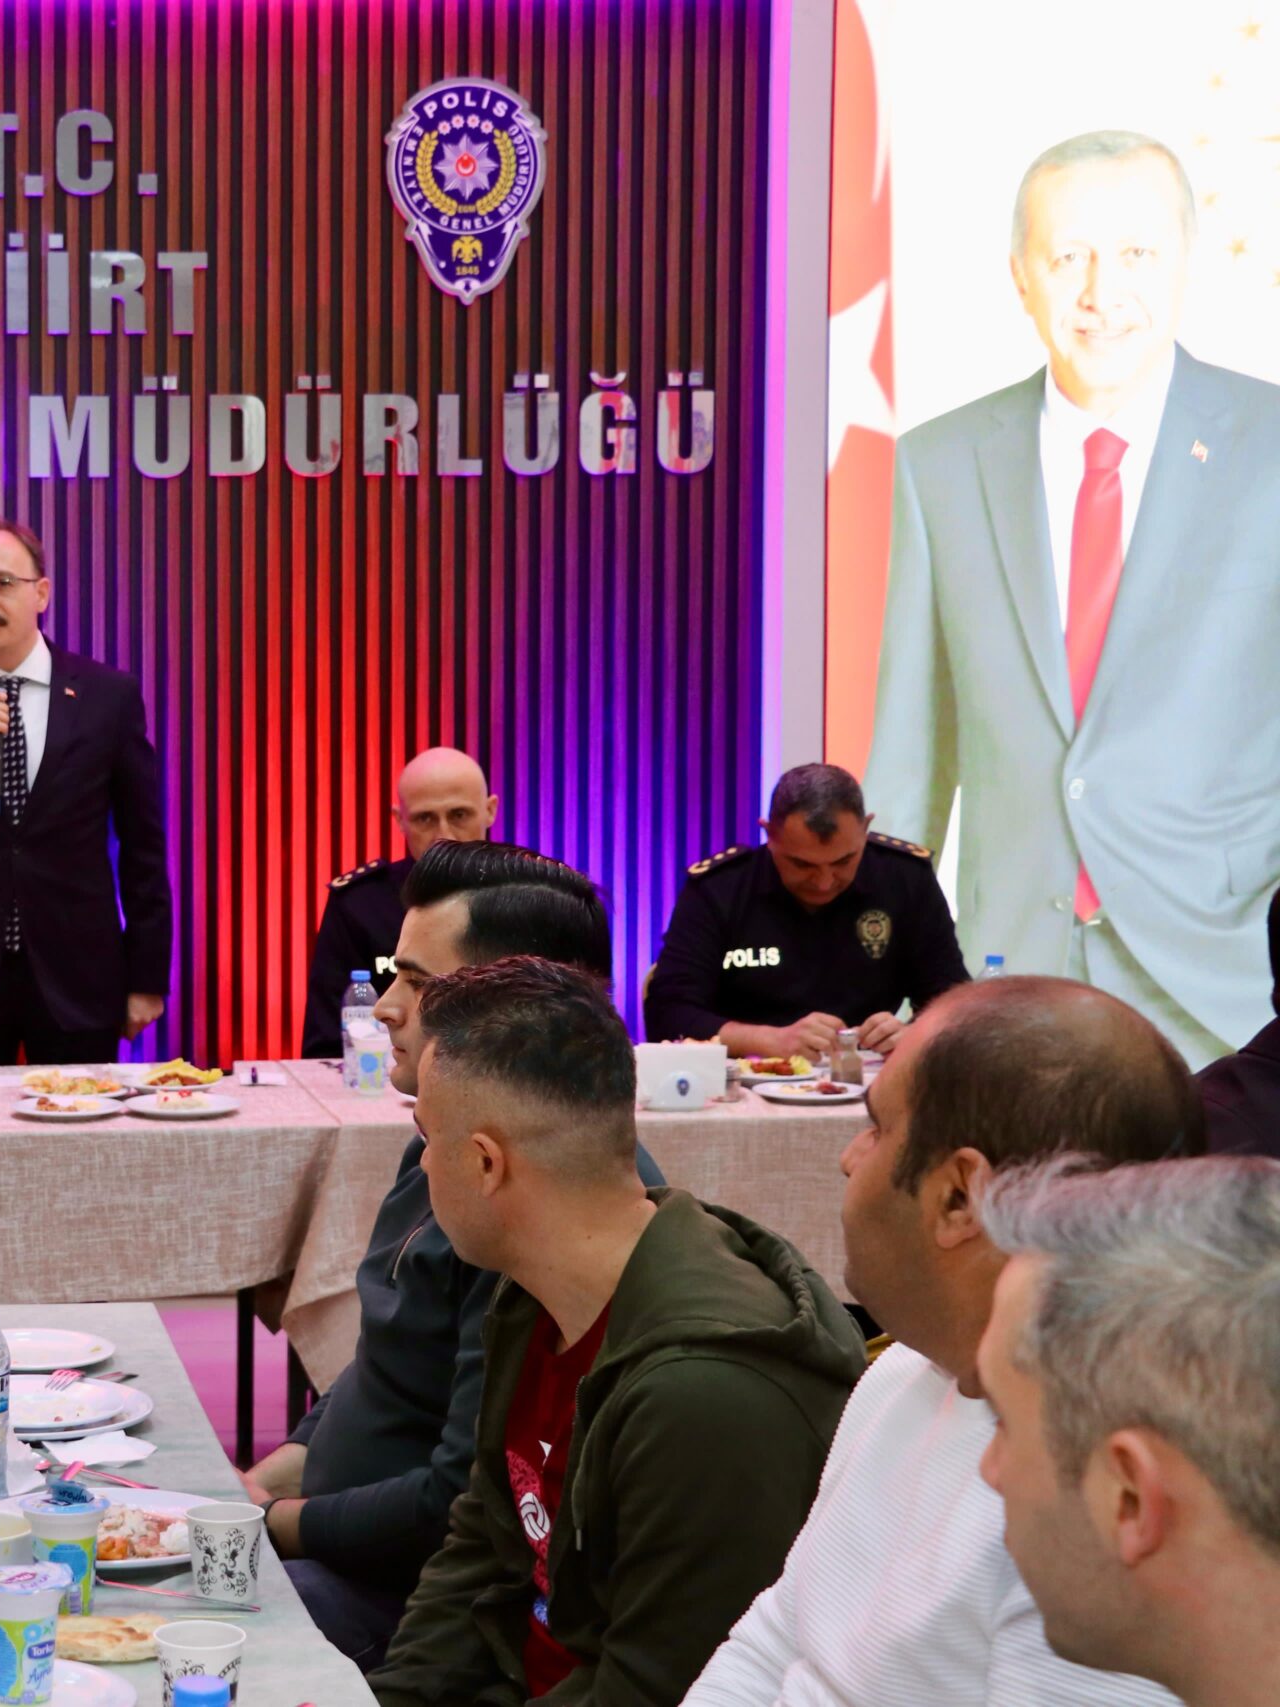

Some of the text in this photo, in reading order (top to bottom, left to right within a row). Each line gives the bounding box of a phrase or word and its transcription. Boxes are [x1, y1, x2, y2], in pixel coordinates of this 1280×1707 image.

[422, 91, 509, 119] POLİS
[439, 215, 494, 230] GENEL
[28, 371, 716, 479] MÜDÜRLÜĞÜ
